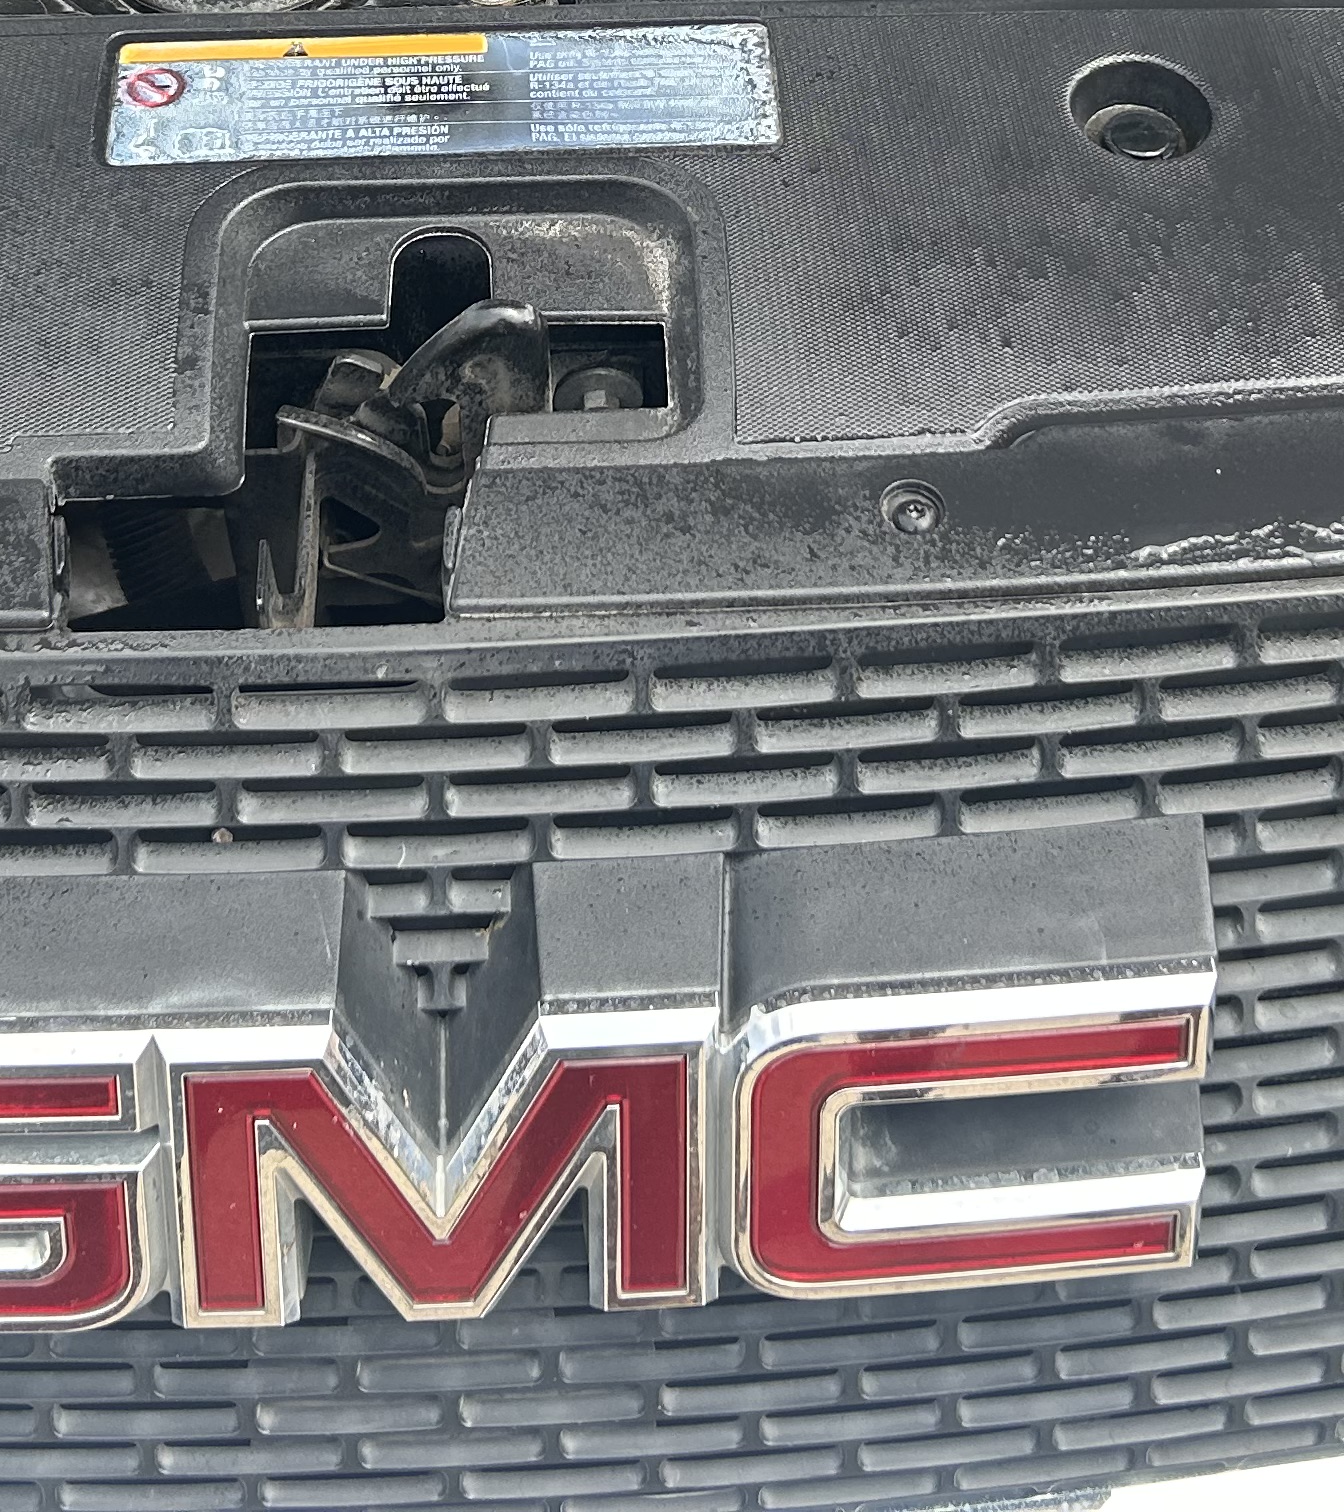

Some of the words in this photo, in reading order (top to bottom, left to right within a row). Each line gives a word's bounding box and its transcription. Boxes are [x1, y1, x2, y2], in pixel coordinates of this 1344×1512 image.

[341, 57, 385, 67] UNDER
[419, 54, 485, 64] PRESSURE
[372, 63, 433, 76] personnel
[435, 61, 463, 74] only.
[358, 126, 391, 137] ALTA
[530, 123, 555, 133] Use
